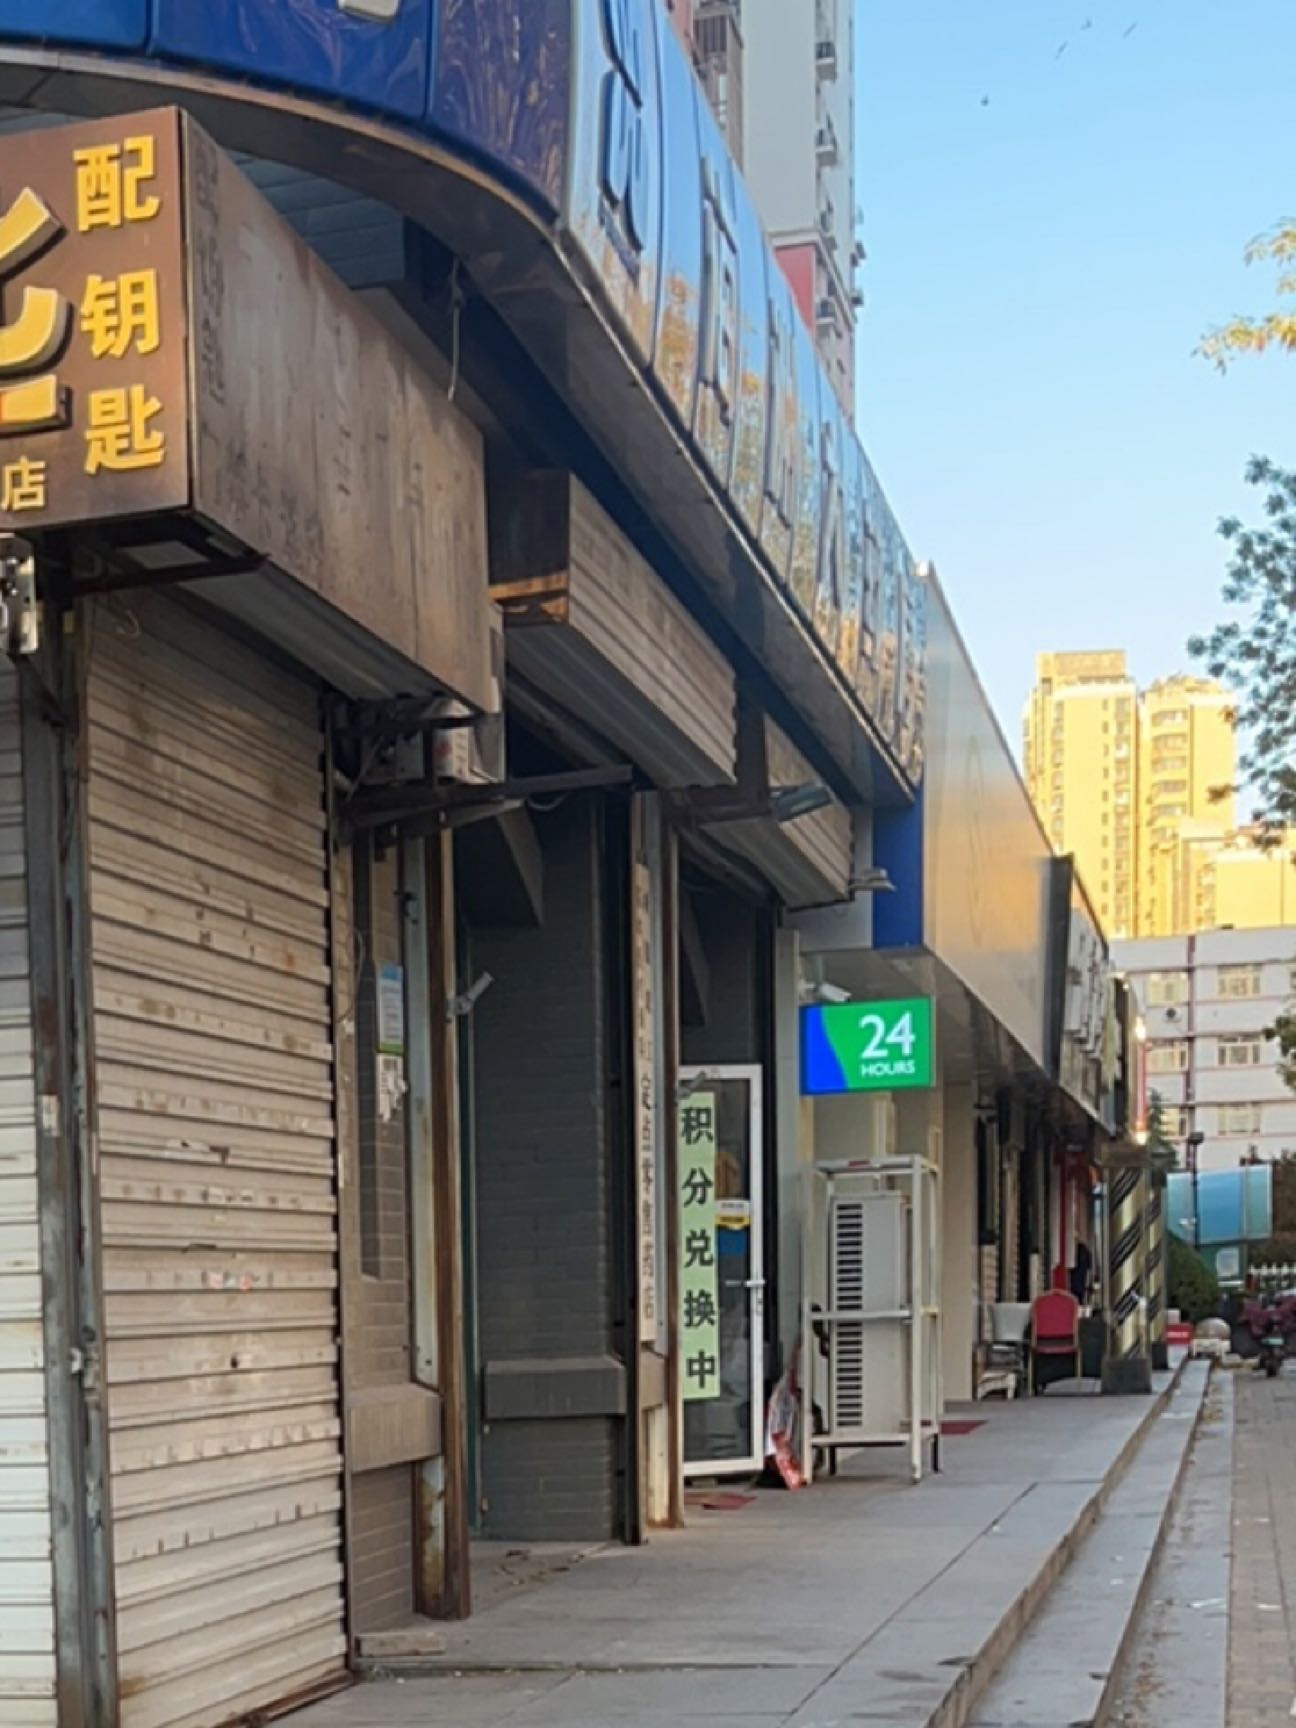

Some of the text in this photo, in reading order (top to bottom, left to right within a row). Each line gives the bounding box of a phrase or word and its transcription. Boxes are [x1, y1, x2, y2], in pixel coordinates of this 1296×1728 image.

[73, 135, 164, 474] 配钥匙
[859, 1010, 915, 1059] 24
[861, 1060, 915, 1077] HOURS
[681, 1107, 716, 1389] 积分兑换中
